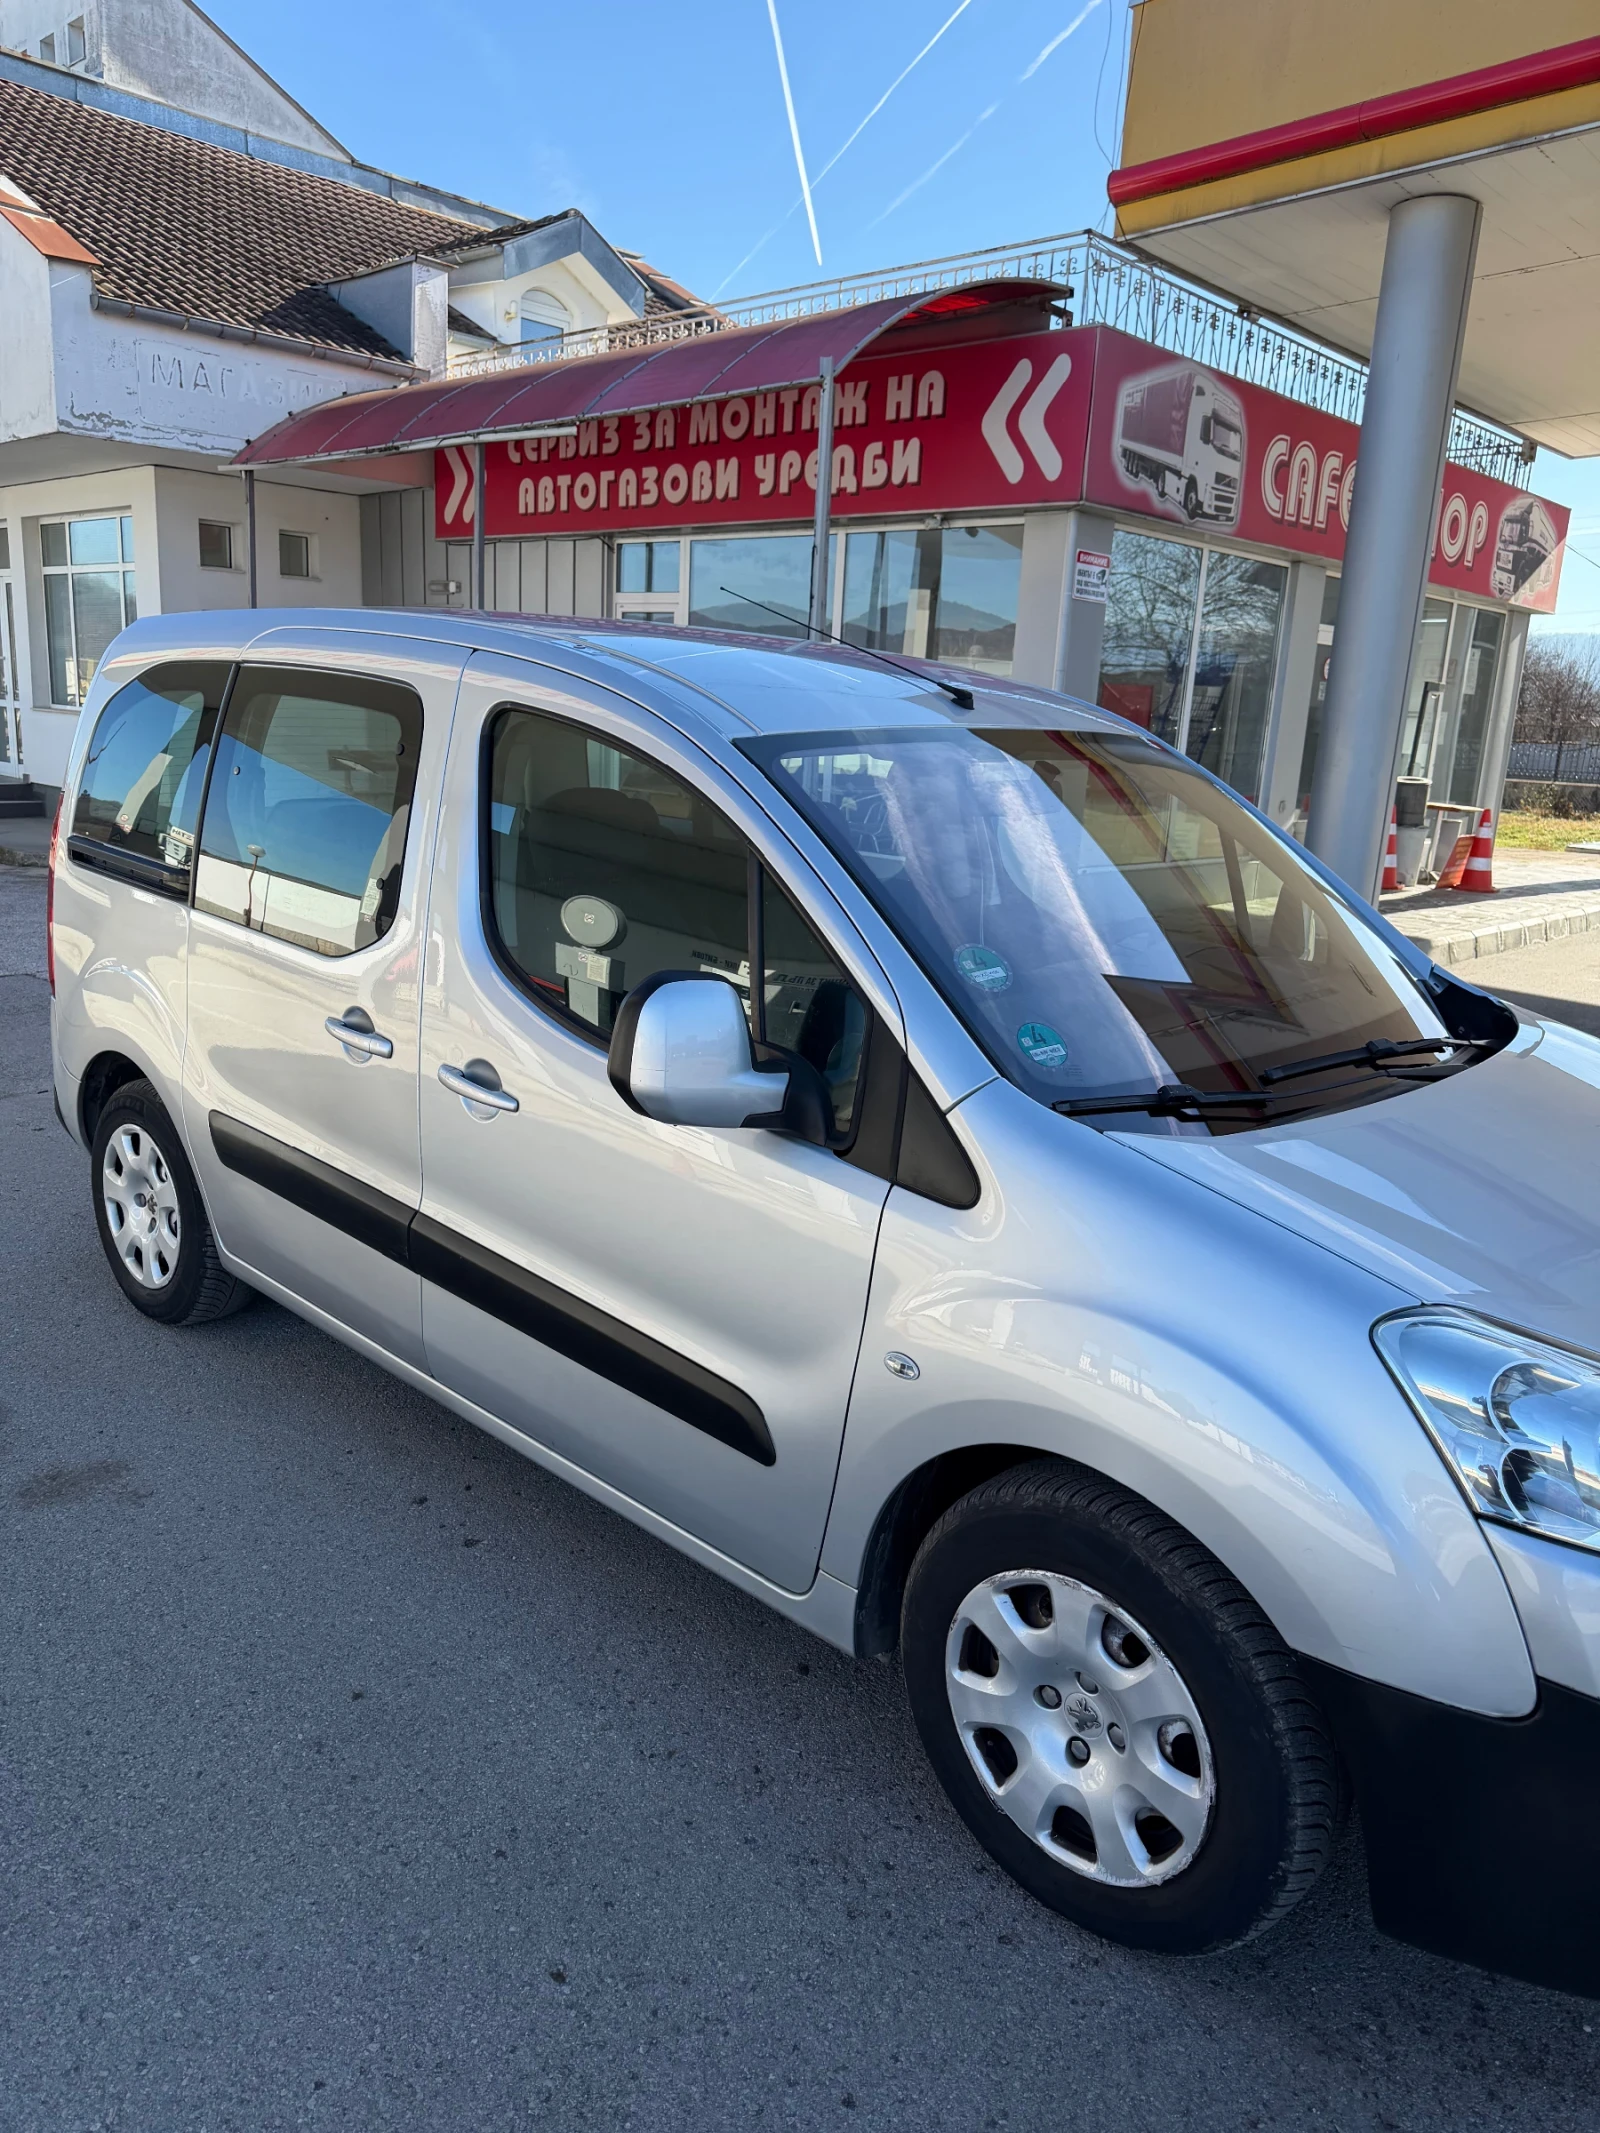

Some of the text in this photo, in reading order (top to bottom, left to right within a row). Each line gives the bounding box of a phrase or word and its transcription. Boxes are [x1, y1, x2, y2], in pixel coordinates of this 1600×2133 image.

[507, 370, 946, 465] СЕРВИЗ ЗА МОНТАЖ НА
[518, 456, 740, 515] АВТОГАЗОВИ
[1030, 1025, 1047, 1045] 4
